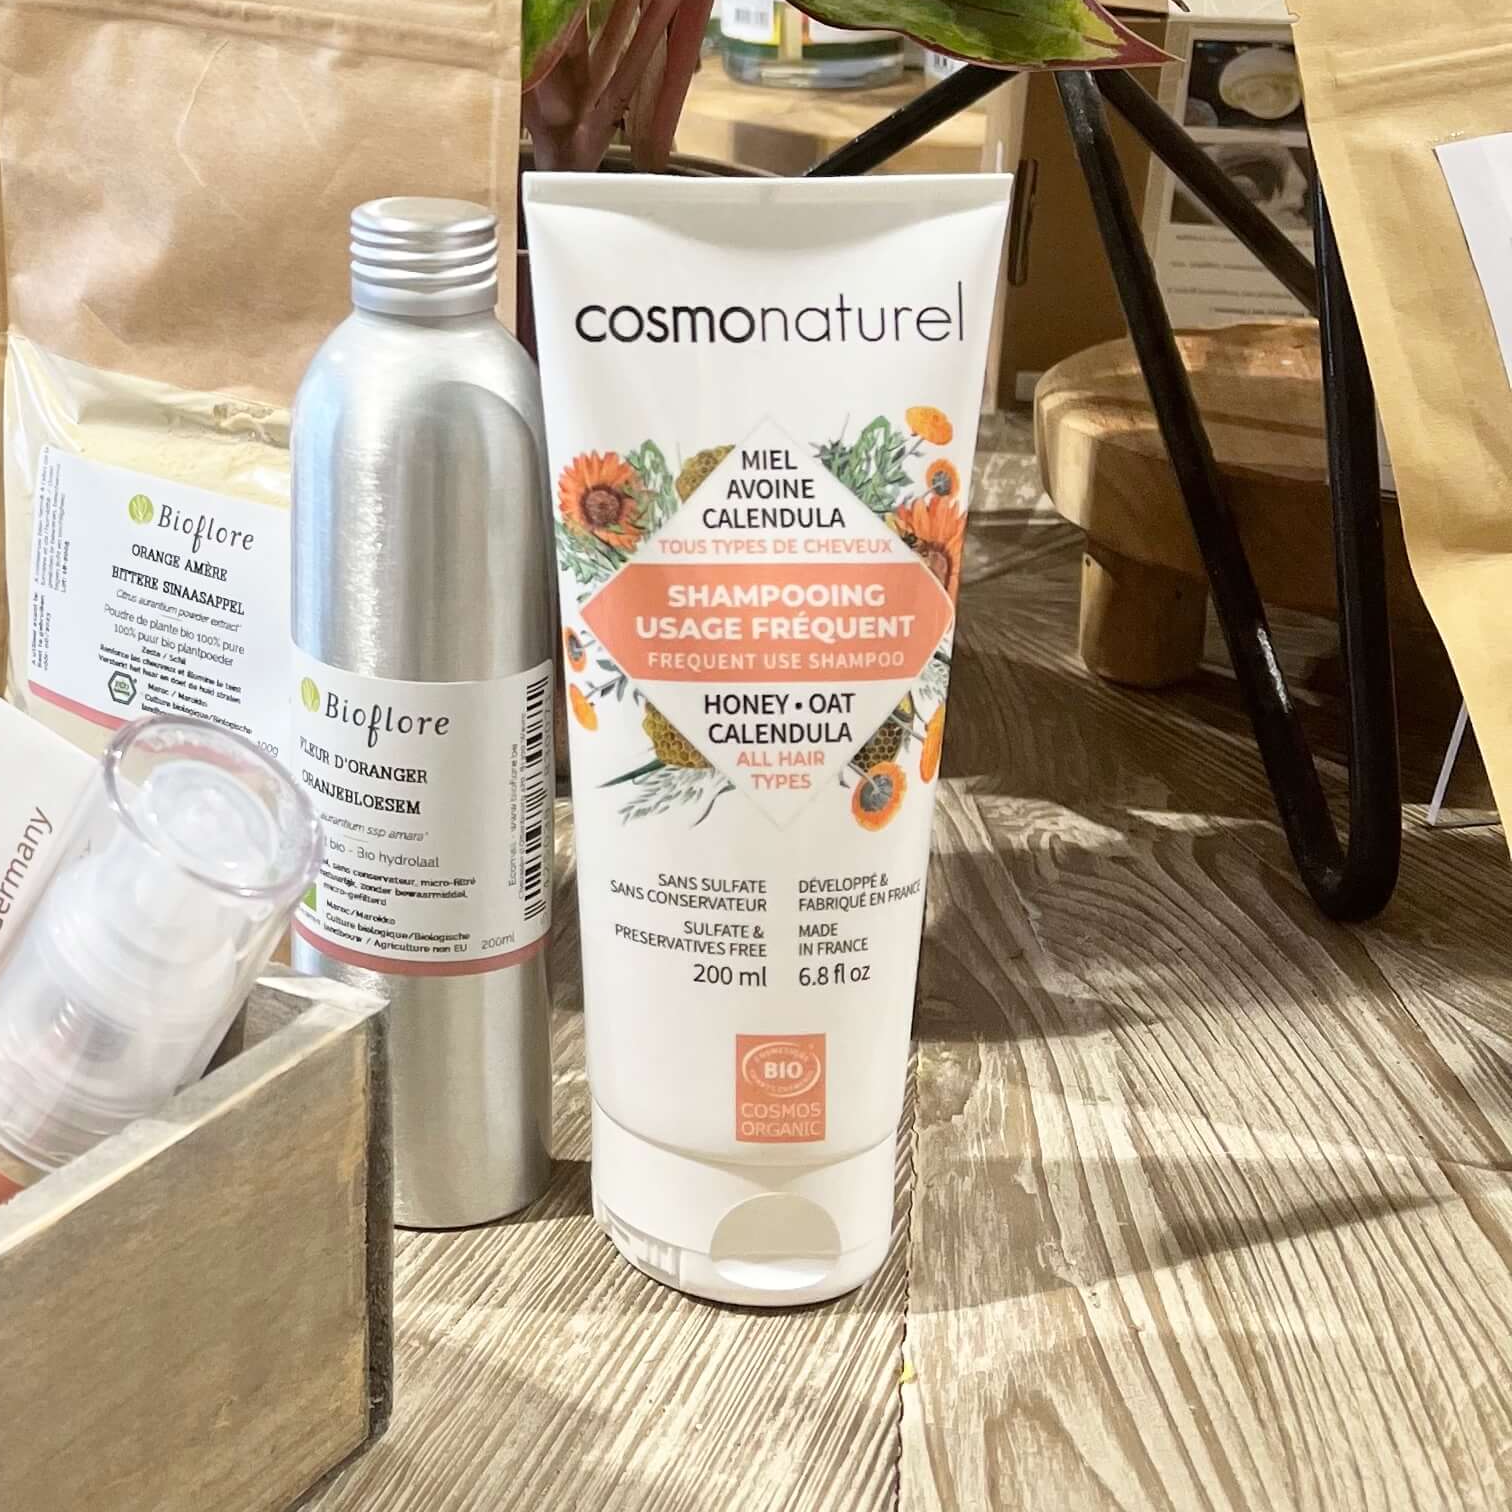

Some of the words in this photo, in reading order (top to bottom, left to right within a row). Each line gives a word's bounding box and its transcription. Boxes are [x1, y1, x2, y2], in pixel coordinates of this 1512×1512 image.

[575, 280, 965, 344] cosmonaturel
[741, 449, 798, 471] MIEL
[727, 478, 816, 501] AVOINE
[157, 503, 255, 554] Bioflore
[702, 507, 846, 530] CALENDULA
[658, 538, 707, 555] TOUS
[711, 538, 767, 555] TYPES
[772, 538, 798, 554] DE
[803, 538, 893, 555] CHEVEUX
[131, 543, 181, 569] ORANGE
[184, 558, 229, 582] AMÈRE
[111, 564, 159, 592] BITTERE
[162, 581, 245, 616] SINAASAPPEL
[667, 583, 886, 609] SHAMPOOING
[104, 602, 135, 623] Poudre
[136, 614, 149, 626] de
[149, 617, 179, 636] plante
[180, 625, 195, 640] bio
[221, 641, 245, 656] pure
[636, 616, 743, 640] USAGE
[751, 613, 915, 645] FRÉQUENT
[137, 630, 159, 644] puur
[160, 636, 176, 650] bio
[177, 641, 234, 666] plantpoeder
[648, 651, 756, 673] FREQUENT
[763, 652, 803, 670] USE
[808, 650, 905, 669] SHAMPOO
[704, 693, 788, 715] HONEY
[808, 693, 856, 715] OAT
[324, 691, 451, 749] Bioflore
[708, 722, 853, 745] CALENDULA
[334, 753, 429, 785] D'ORANGER
[735, 750, 773, 767] ALL
[778, 750, 826, 767] HAIR
[301, 769, 422, 816] ORANJEBLOESEM
[751, 774, 811, 790] TYPES
[329, 839, 346, 853] bio
[356, 846, 376, 862] Bio
[657, 873, 698, 891] SANS
[701, 877, 768, 894] SULFATE
[798, 871, 878, 894] DÉVELOPPÉ
[879, 872, 889, 887] &
[609, 879, 645, 901] SANS
[646, 890, 768, 913] CONSERVATEUR
[798, 891, 867, 913] FABRIQUÉ
[868, 891, 886, 908] EN
[887, 878, 922, 905] FRANCE
[614, 924, 726, 956] PRESERVATIVES
[729, 941, 768, 958] FREE
[682, 920, 750, 939] SULFATE
[752, 925, 765, 939] &
[798, 922, 838, 938] MADE
[452, 942, 468, 953] EU
[798, 942, 814, 957] IN
[816, 937, 869, 956] FRANCE
[692, 963, 733, 986] 200
[737, 965, 768, 987] ml
[798, 965, 829, 987] 6.8
[833, 963, 846, 985] fl
[849, 964, 871, 982] oz
[763, 1060, 804, 1080] BIO
[741, 1101, 823, 1120] COSMOS
[741, 1120, 822, 1137] ORGANIC
